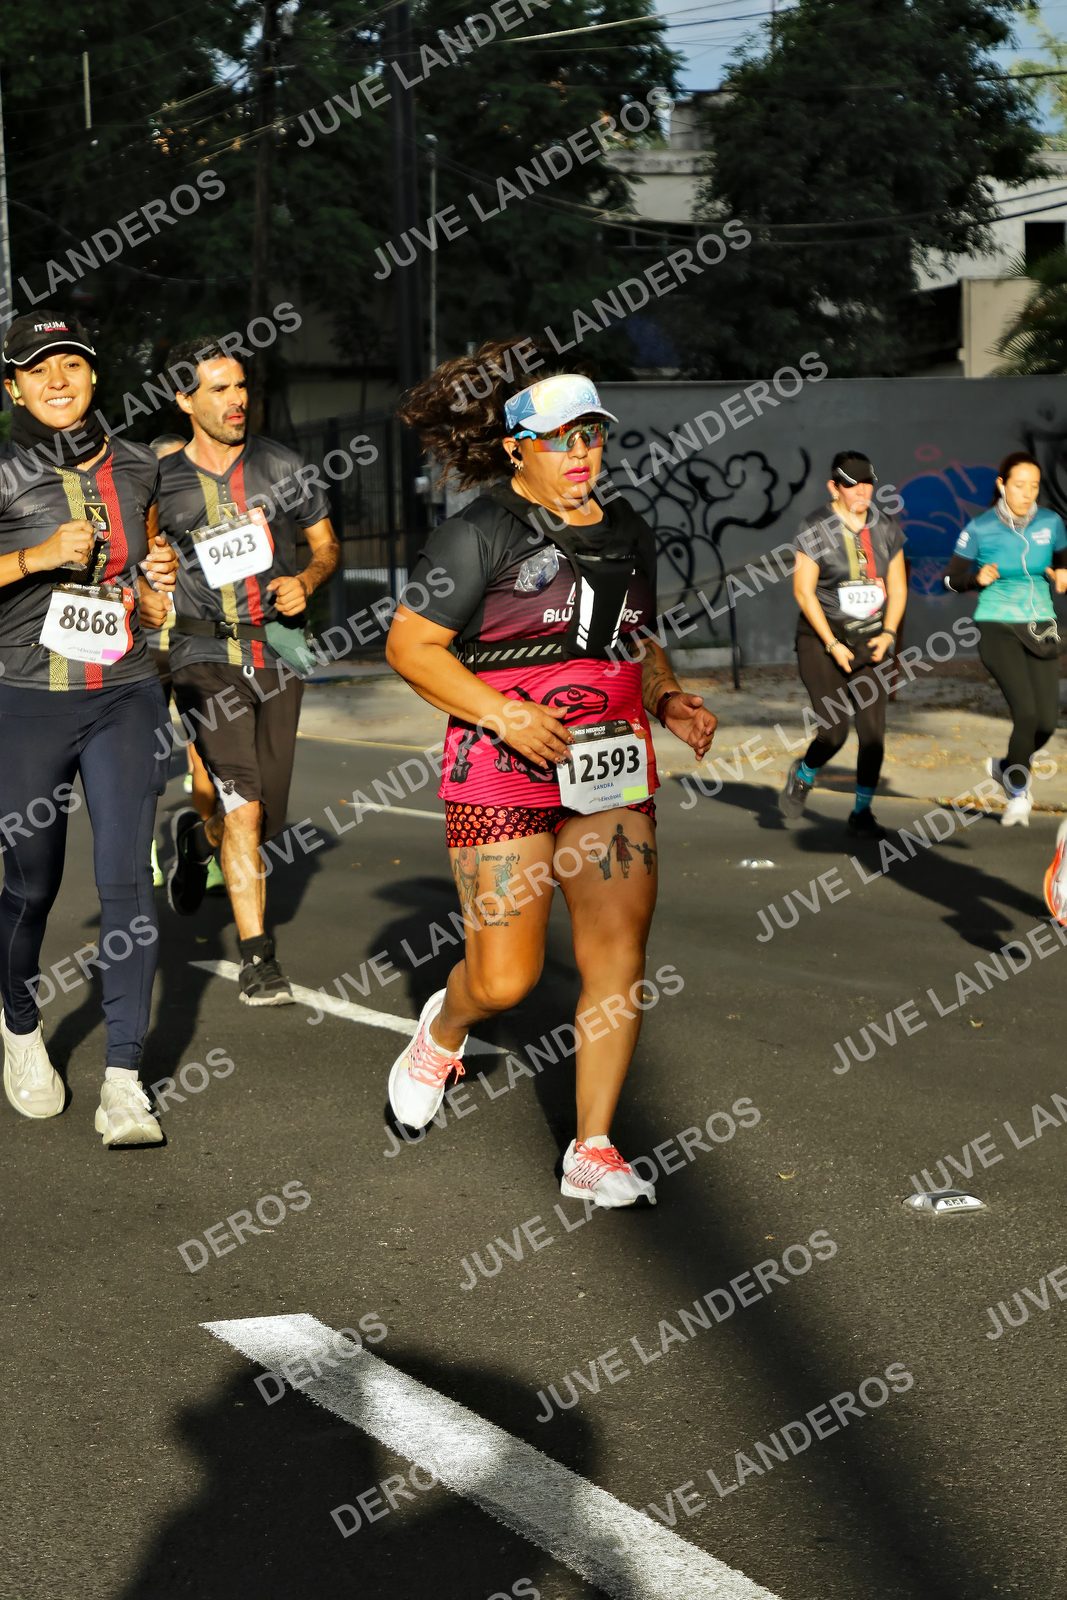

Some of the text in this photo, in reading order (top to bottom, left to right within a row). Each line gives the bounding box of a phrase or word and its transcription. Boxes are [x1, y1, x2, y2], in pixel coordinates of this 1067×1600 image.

[208, 533, 257, 565] 9423
[847, 590, 877, 605] 9225
[59, 604, 118, 637] 8868
[563, 744, 641, 785] 12593
[593, 781, 615, 791] SANDRA
